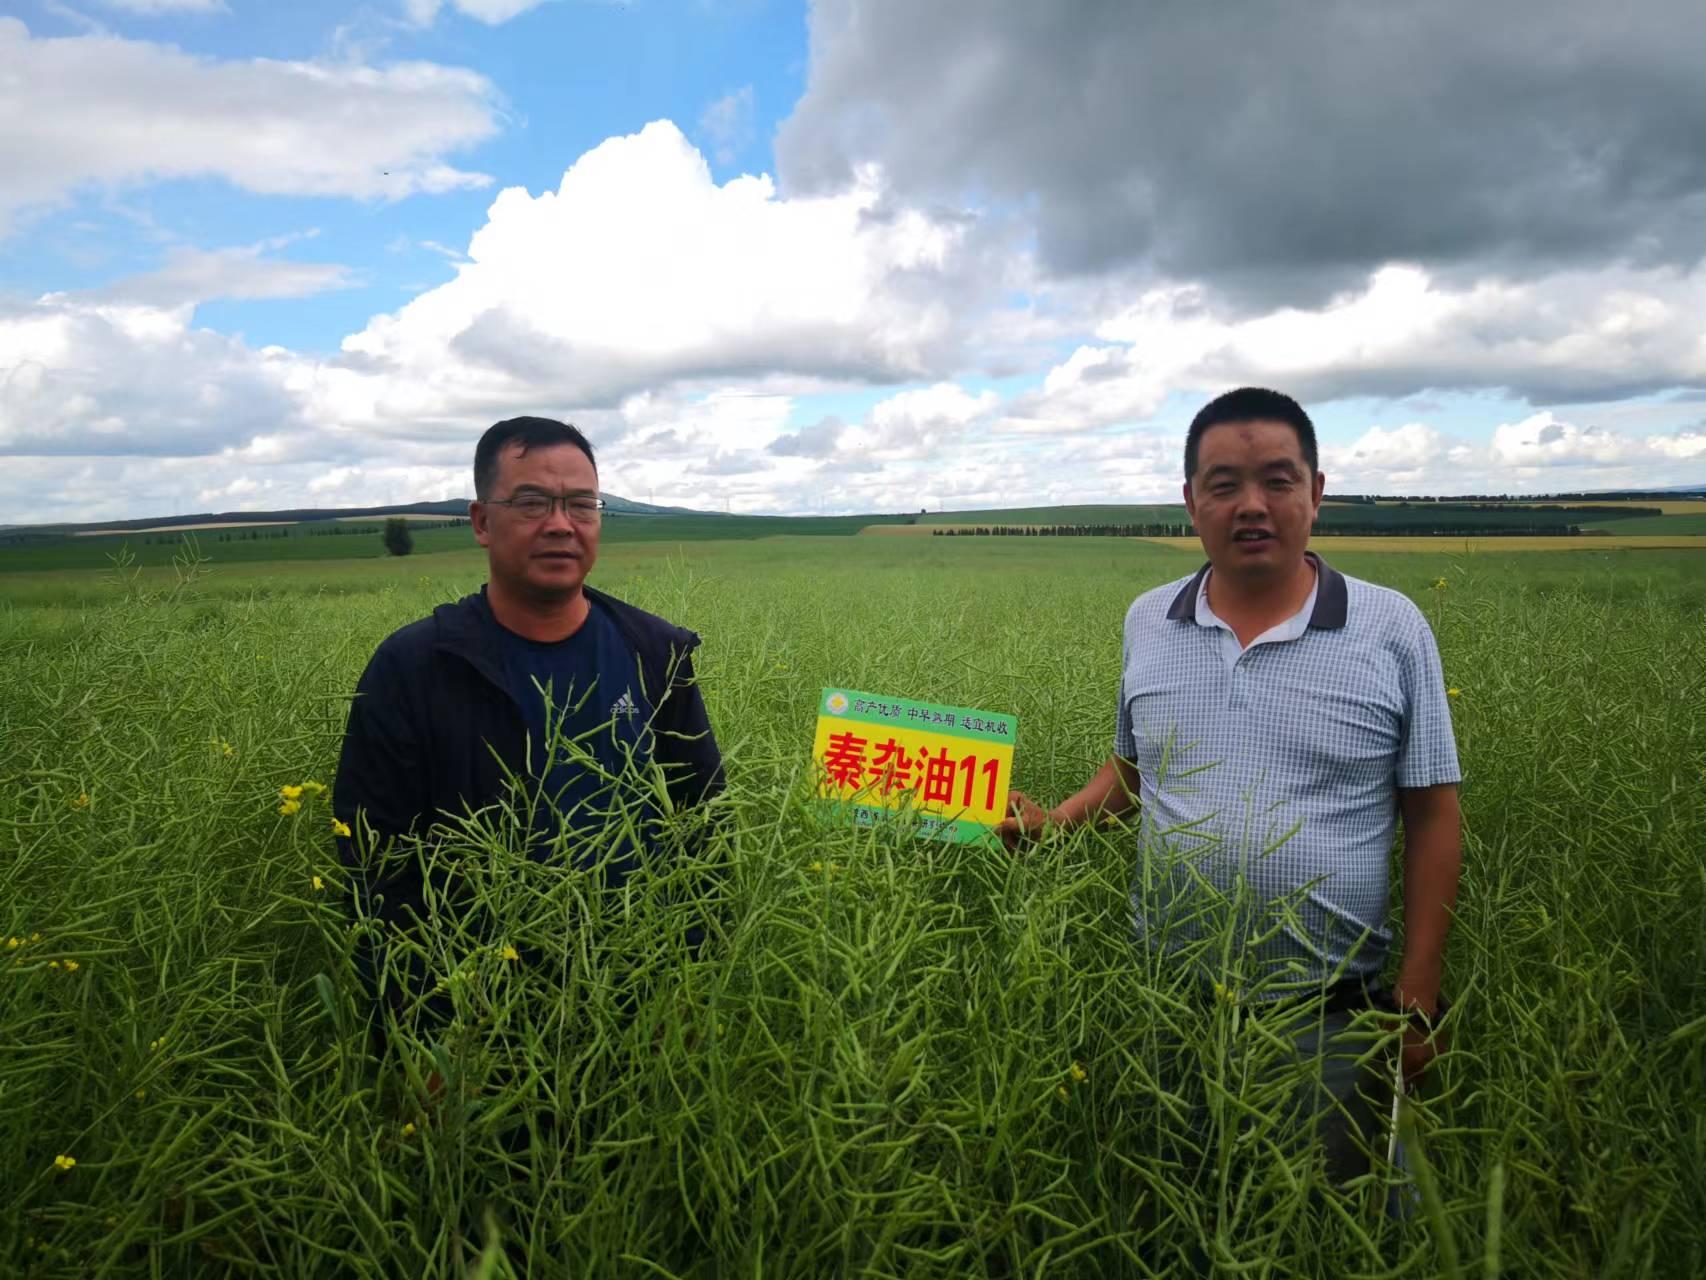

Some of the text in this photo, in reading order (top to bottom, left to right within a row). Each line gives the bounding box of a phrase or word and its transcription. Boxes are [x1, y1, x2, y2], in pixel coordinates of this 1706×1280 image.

[610, 706, 640, 714] adidas
[853, 699, 902, 717] 高产优质
[960, 717, 1009, 736] 适宜机收
[824, 732, 1000, 811] 秦杂油11
